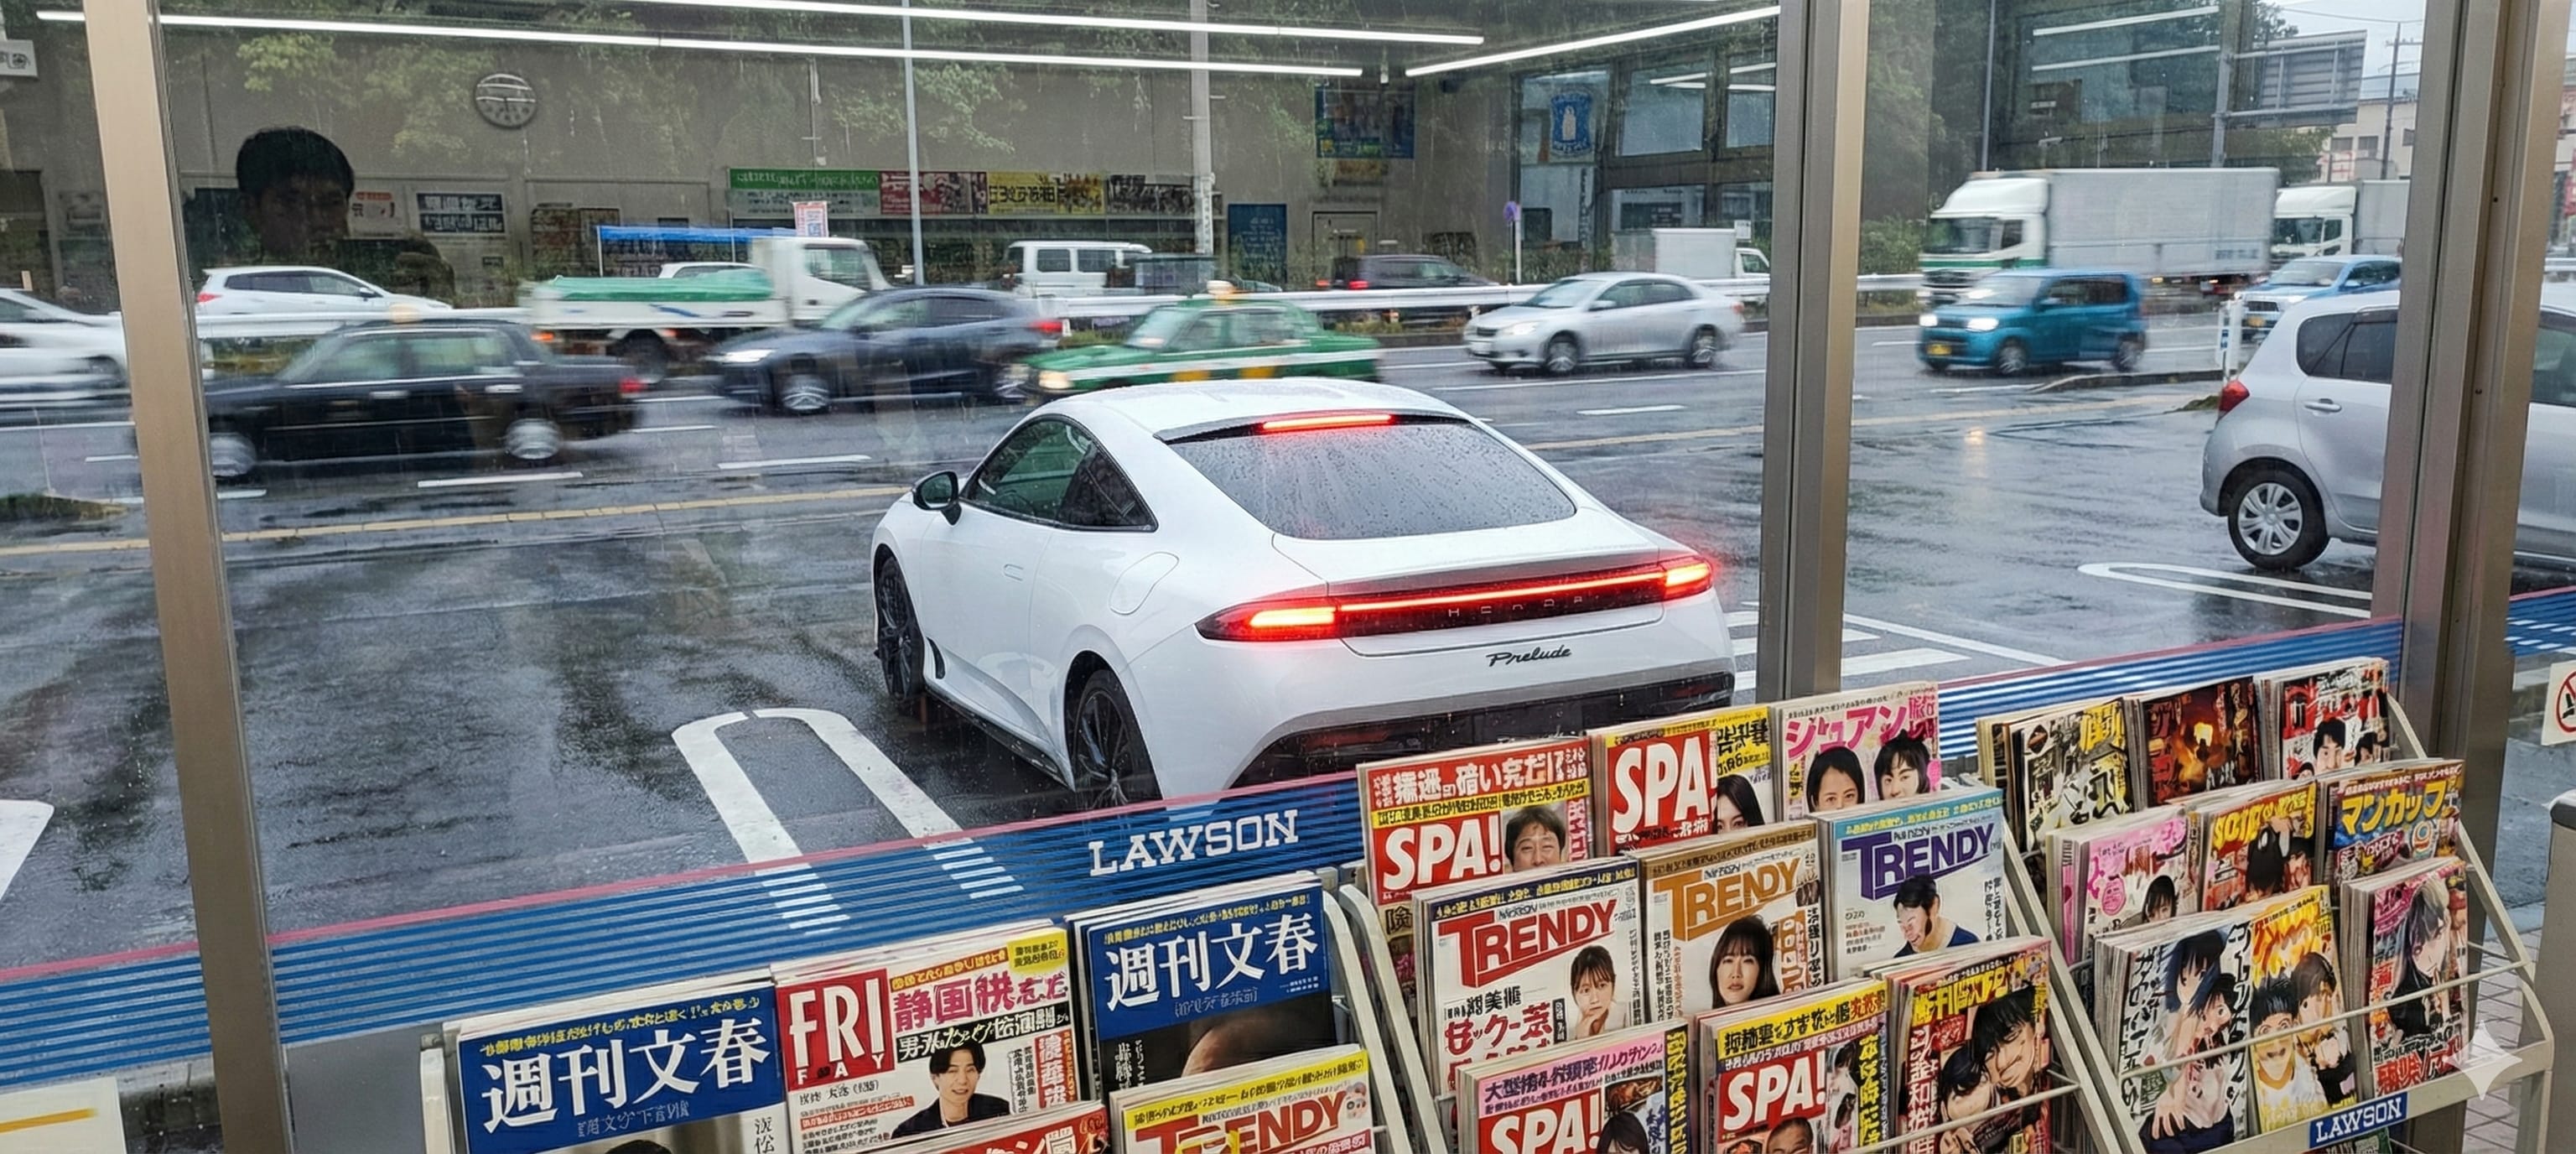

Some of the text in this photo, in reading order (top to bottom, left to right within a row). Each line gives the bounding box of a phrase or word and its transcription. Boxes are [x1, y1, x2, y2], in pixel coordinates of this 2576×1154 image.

[1486, 645, 1572, 667] Prelude
[1088, 809, 1299, 876] LAWSON
[1384, 814, 1502, 891] SPA!
[1841, 822, 1996, 902] TRENDY
[1654, 857, 1801, 943] TRENDY
[1105, 912, 1318, 1011] 週刊文春
[1438, 899, 1618, 989] TRENDY
[789, 977, 885, 1069] FRI
[481, 1017, 771, 1133] 週刊文春
[1723, 1050, 1826, 1131] SPA!
[1491, 1093, 1605, 1154] SPA!
[2316, 1097, 2402, 1143] LAWSON
